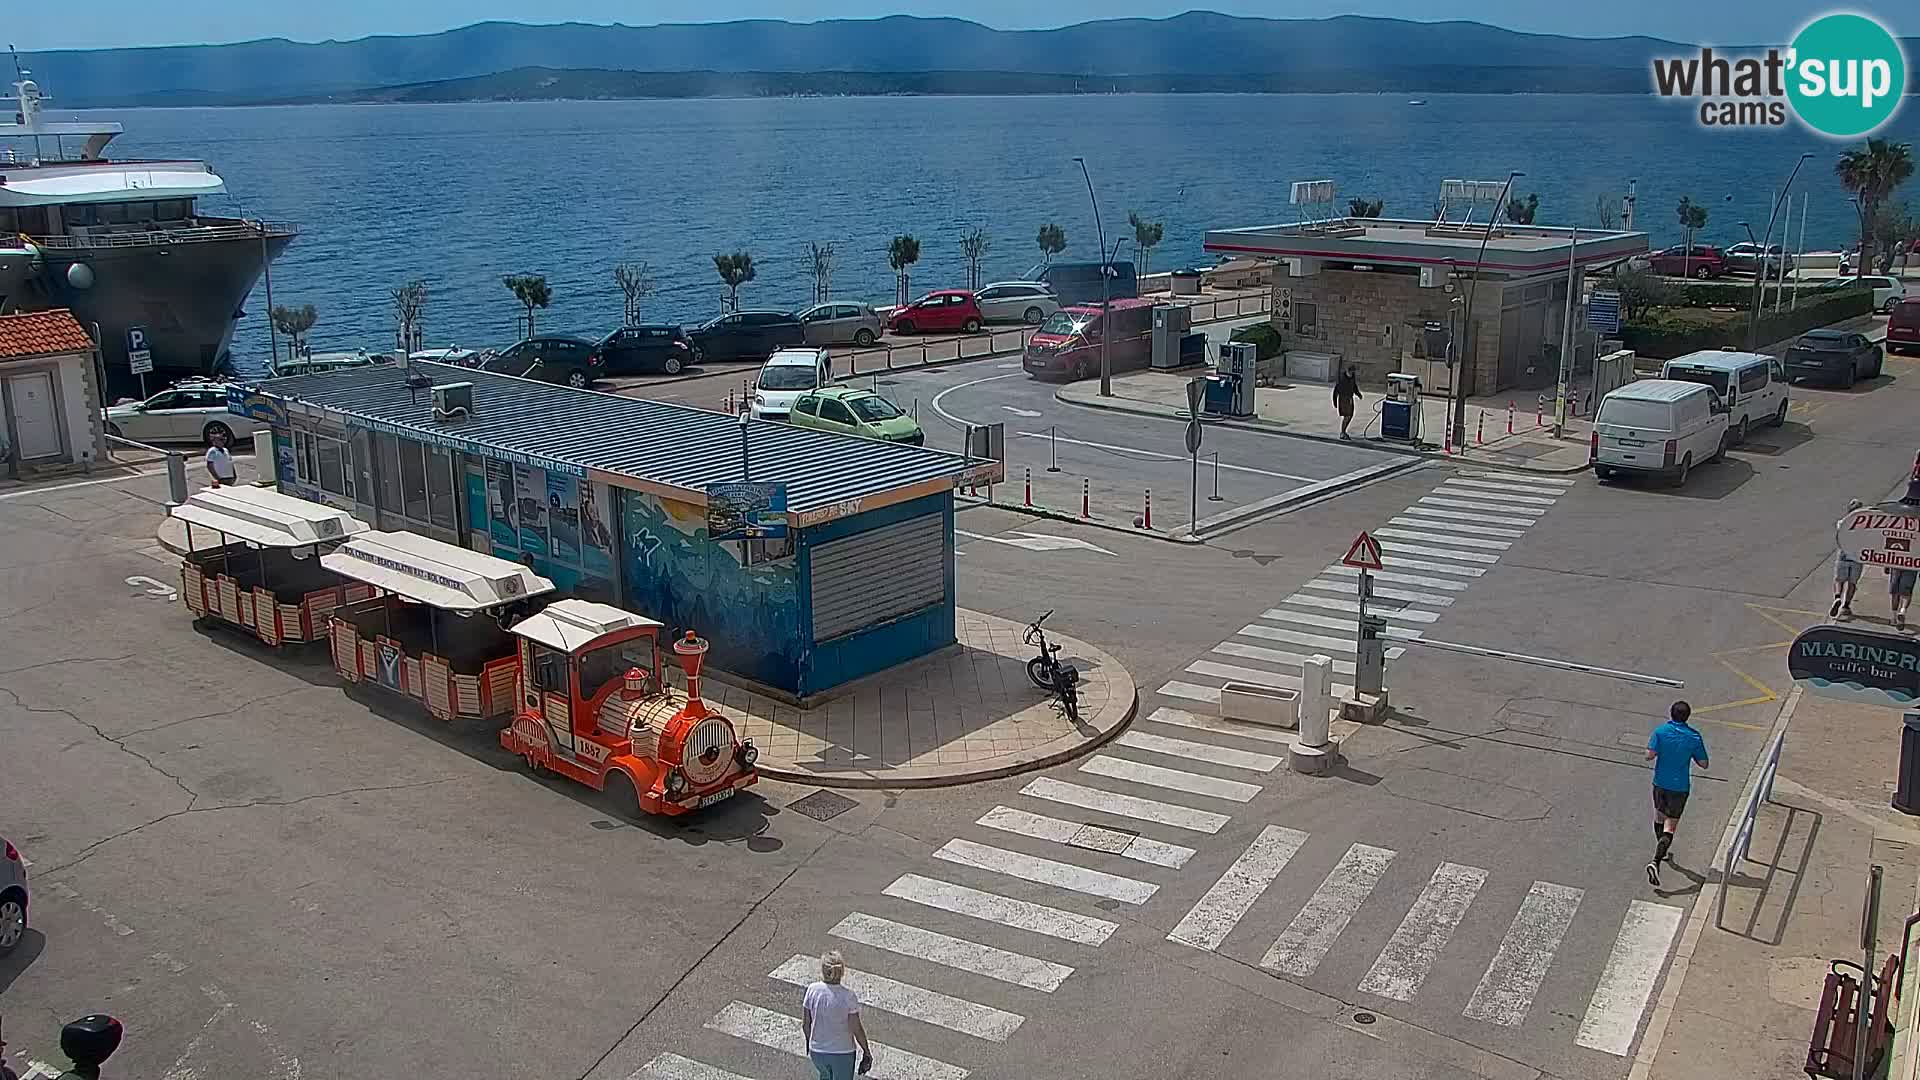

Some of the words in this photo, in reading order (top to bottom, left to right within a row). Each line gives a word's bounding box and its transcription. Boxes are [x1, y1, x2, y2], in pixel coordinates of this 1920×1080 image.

[131, 330, 143, 348] P
[437, 435, 468, 450] POSTAJA
[480, 446, 494, 456] BUS
[495, 449, 527, 464] STATION
[529, 456, 554, 470] TICKET
[556, 462, 583, 476] OFFICE
[839, 499, 862, 516] SKY
[1848, 514, 1920, 532] PIZZE
[1882, 529, 1916, 540] GRILL
[1802, 641, 1920, 672] MARINER
[1829, 662, 1866, 675] caffe
[1870, 665, 1897, 679] bar
